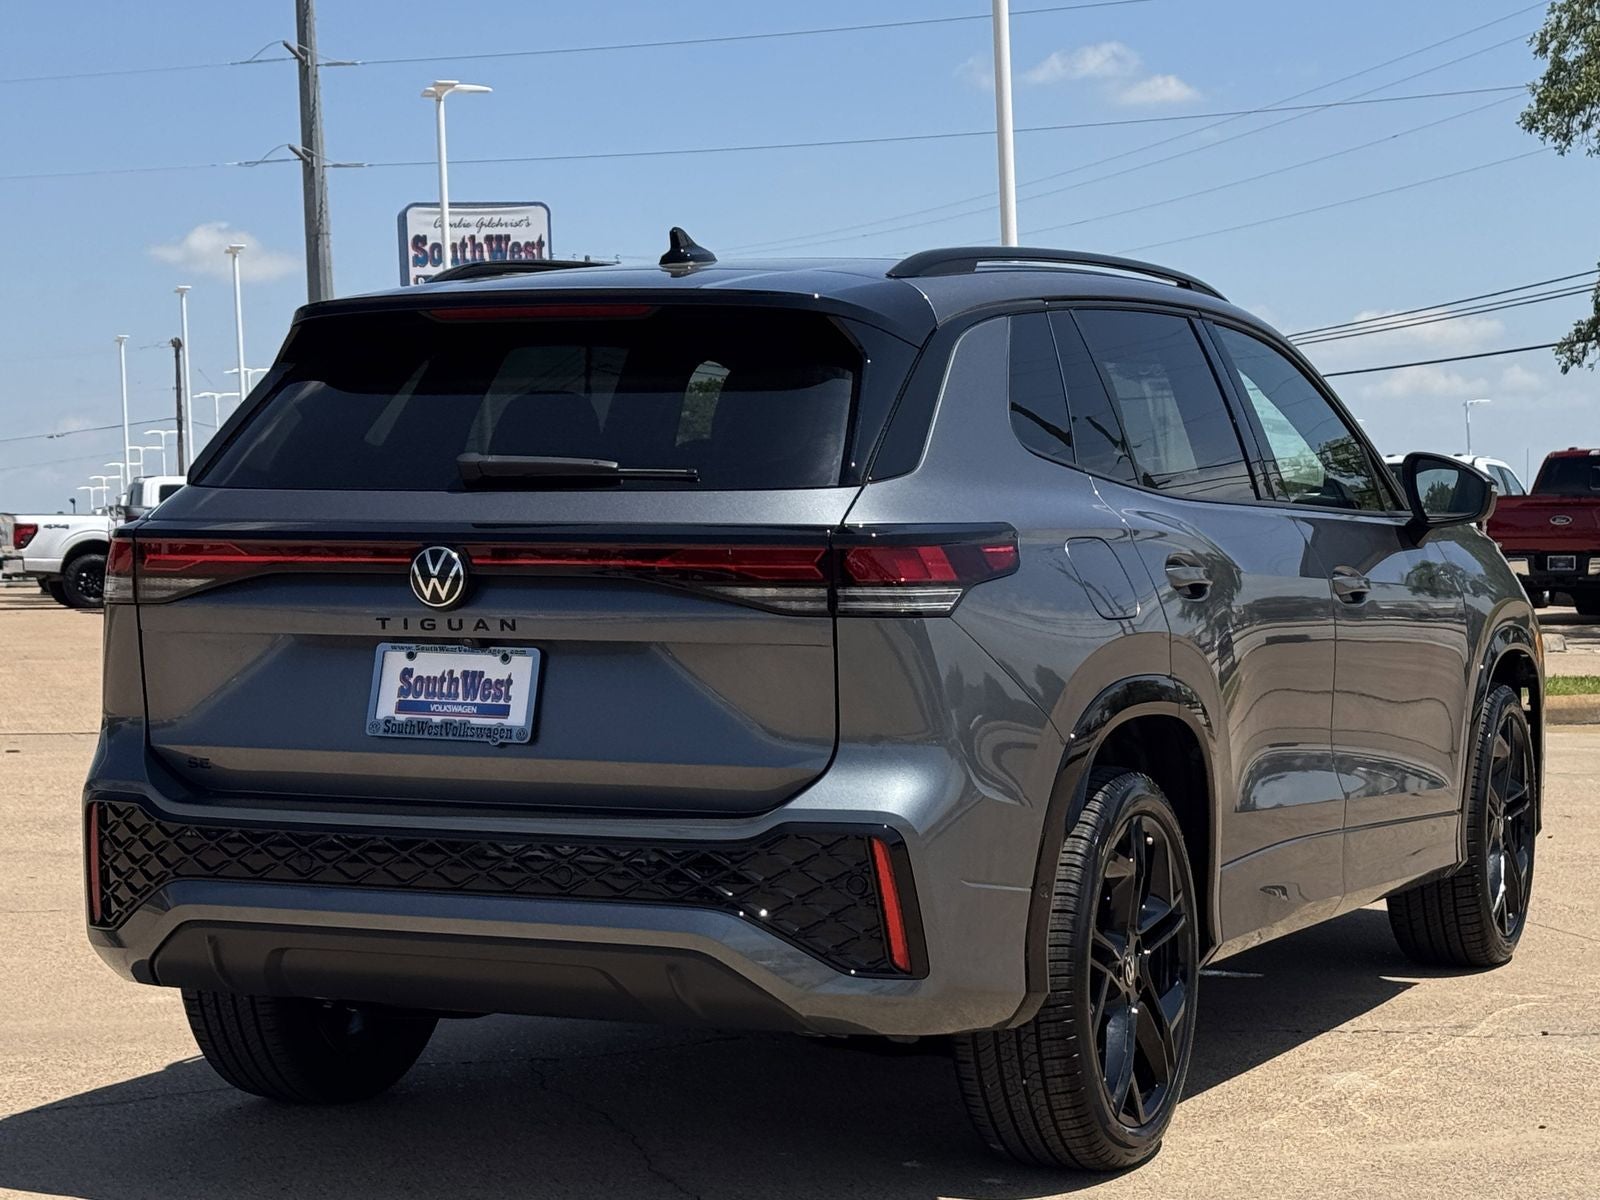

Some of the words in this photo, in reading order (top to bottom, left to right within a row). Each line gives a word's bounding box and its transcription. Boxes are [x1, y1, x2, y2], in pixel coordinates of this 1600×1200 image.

[433, 217, 471, 228] Crlie
[475, 216, 532, 233] Gilchrist's
[376, 617, 517, 632] TIGUAN
[398, 667, 513, 703] SouthWest
[430, 703, 477, 713] VOLKSWAGEN
[383, 719, 512, 743] SouthWestVolkswagen
[188, 756, 212, 769] SE
